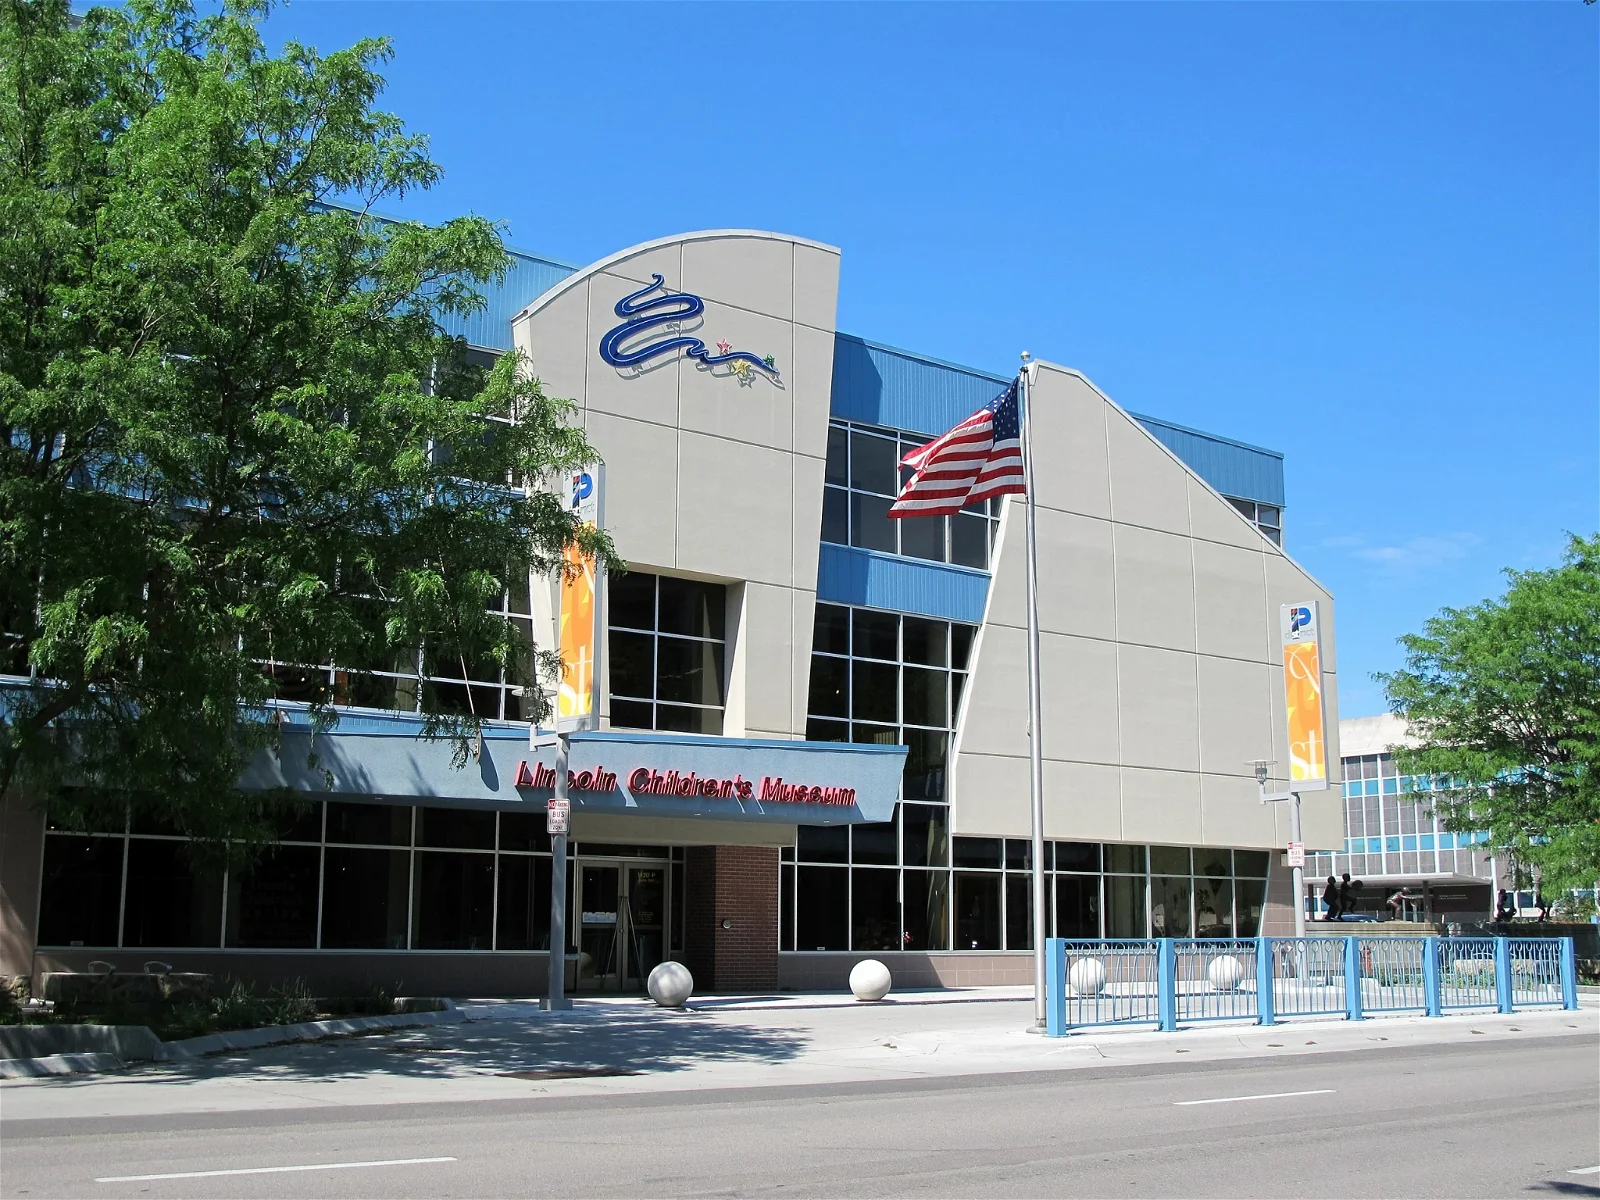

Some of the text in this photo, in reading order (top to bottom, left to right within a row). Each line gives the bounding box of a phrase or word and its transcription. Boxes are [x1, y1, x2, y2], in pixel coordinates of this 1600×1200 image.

[1290, 607, 1312, 639] P
[627, 767, 753, 799] Children's
[757, 776, 857, 806] Museum
